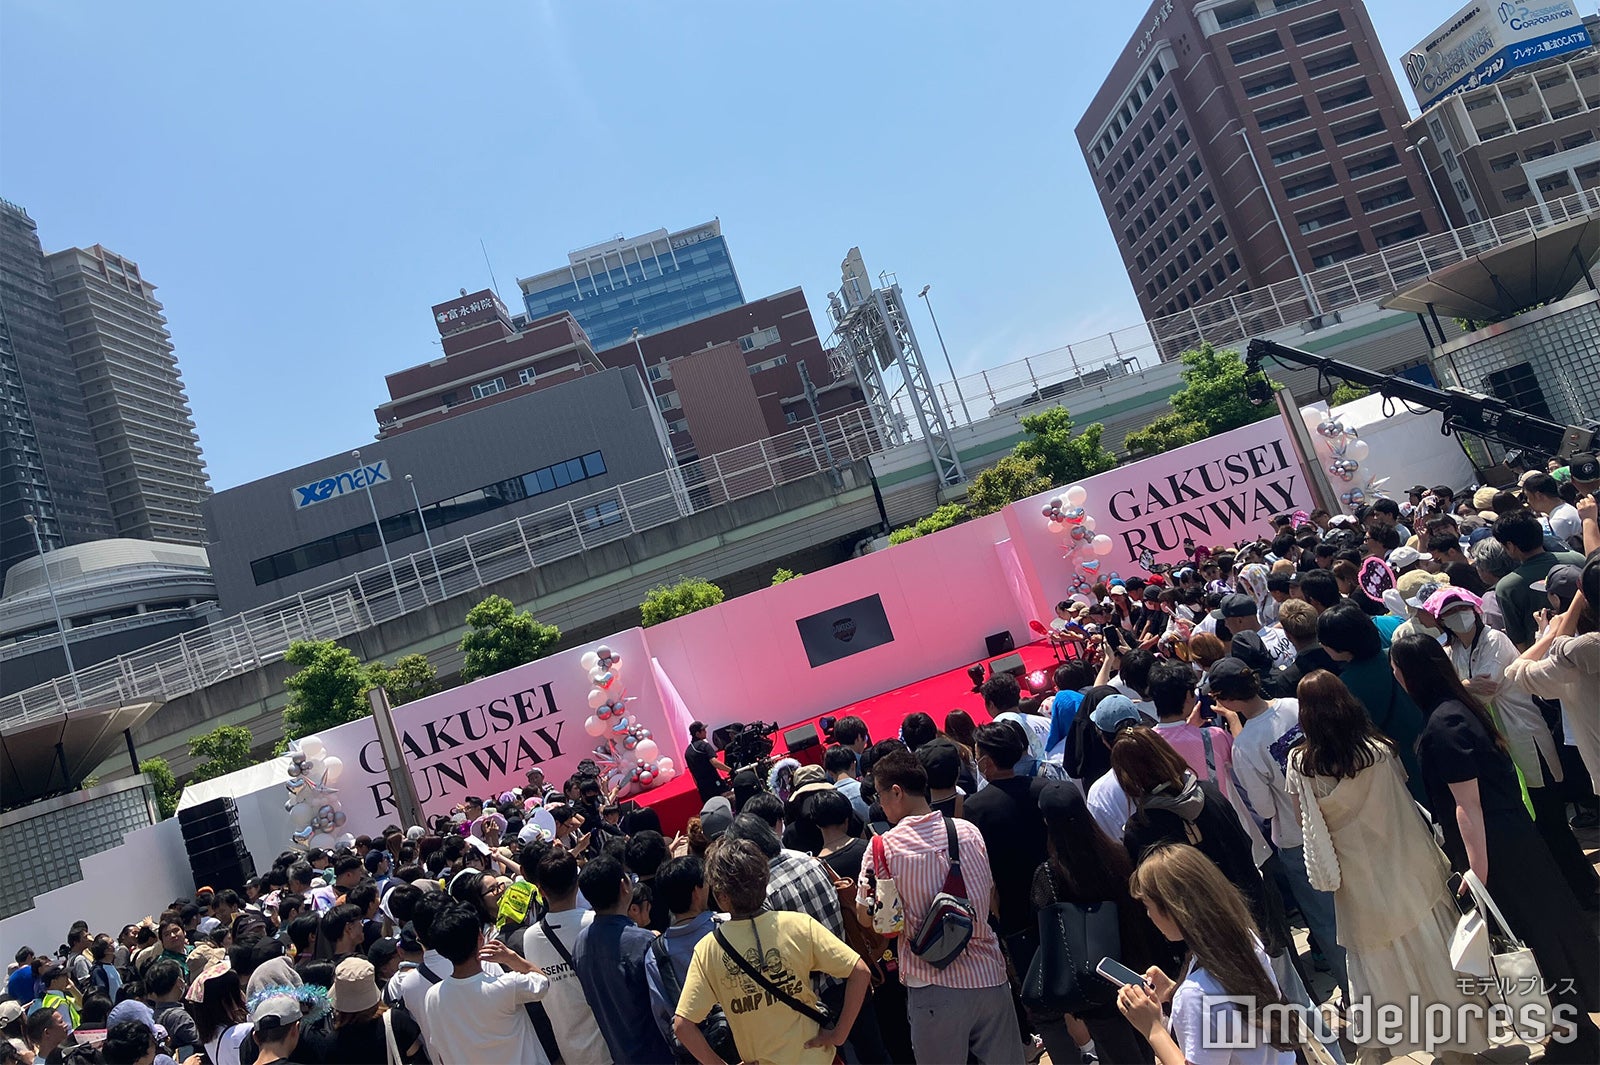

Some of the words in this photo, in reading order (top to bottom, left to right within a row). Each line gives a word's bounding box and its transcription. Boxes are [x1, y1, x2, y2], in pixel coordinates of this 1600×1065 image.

[1510, 8, 1573, 31] CORPORATION
[296, 462, 388, 507] xanax
[1108, 439, 1292, 523] GAKUSEI
[1119, 475, 1300, 563] RUNWAY
